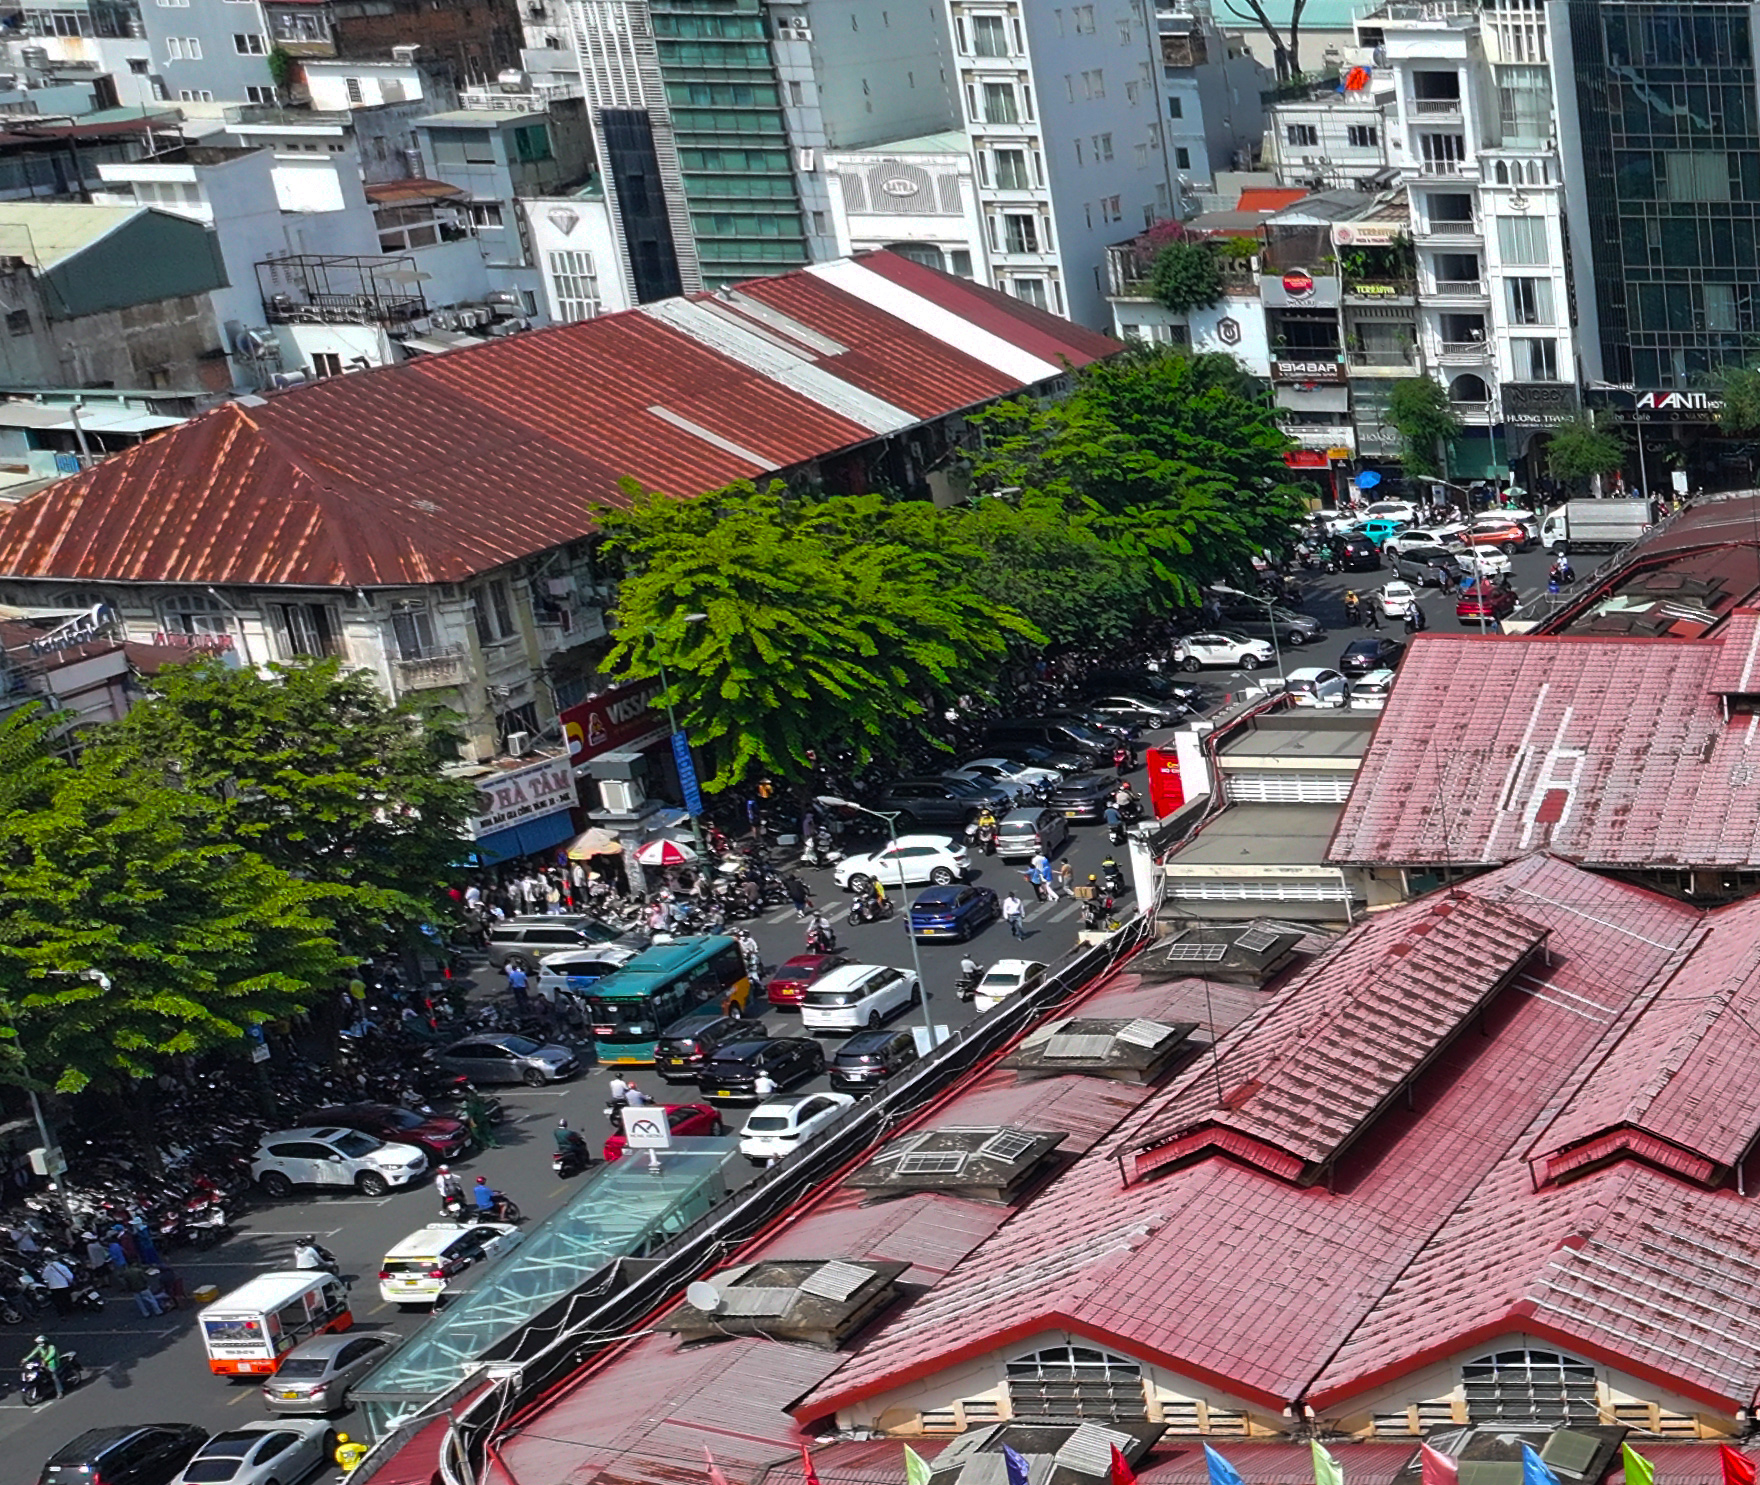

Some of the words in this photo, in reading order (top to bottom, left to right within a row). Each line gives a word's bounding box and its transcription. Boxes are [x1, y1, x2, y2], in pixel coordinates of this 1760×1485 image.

[1279, 363, 1305, 372] 1914
[1307, 363, 1338, 372] BAR
[1637, 393, 1707, 409] AVANTI
